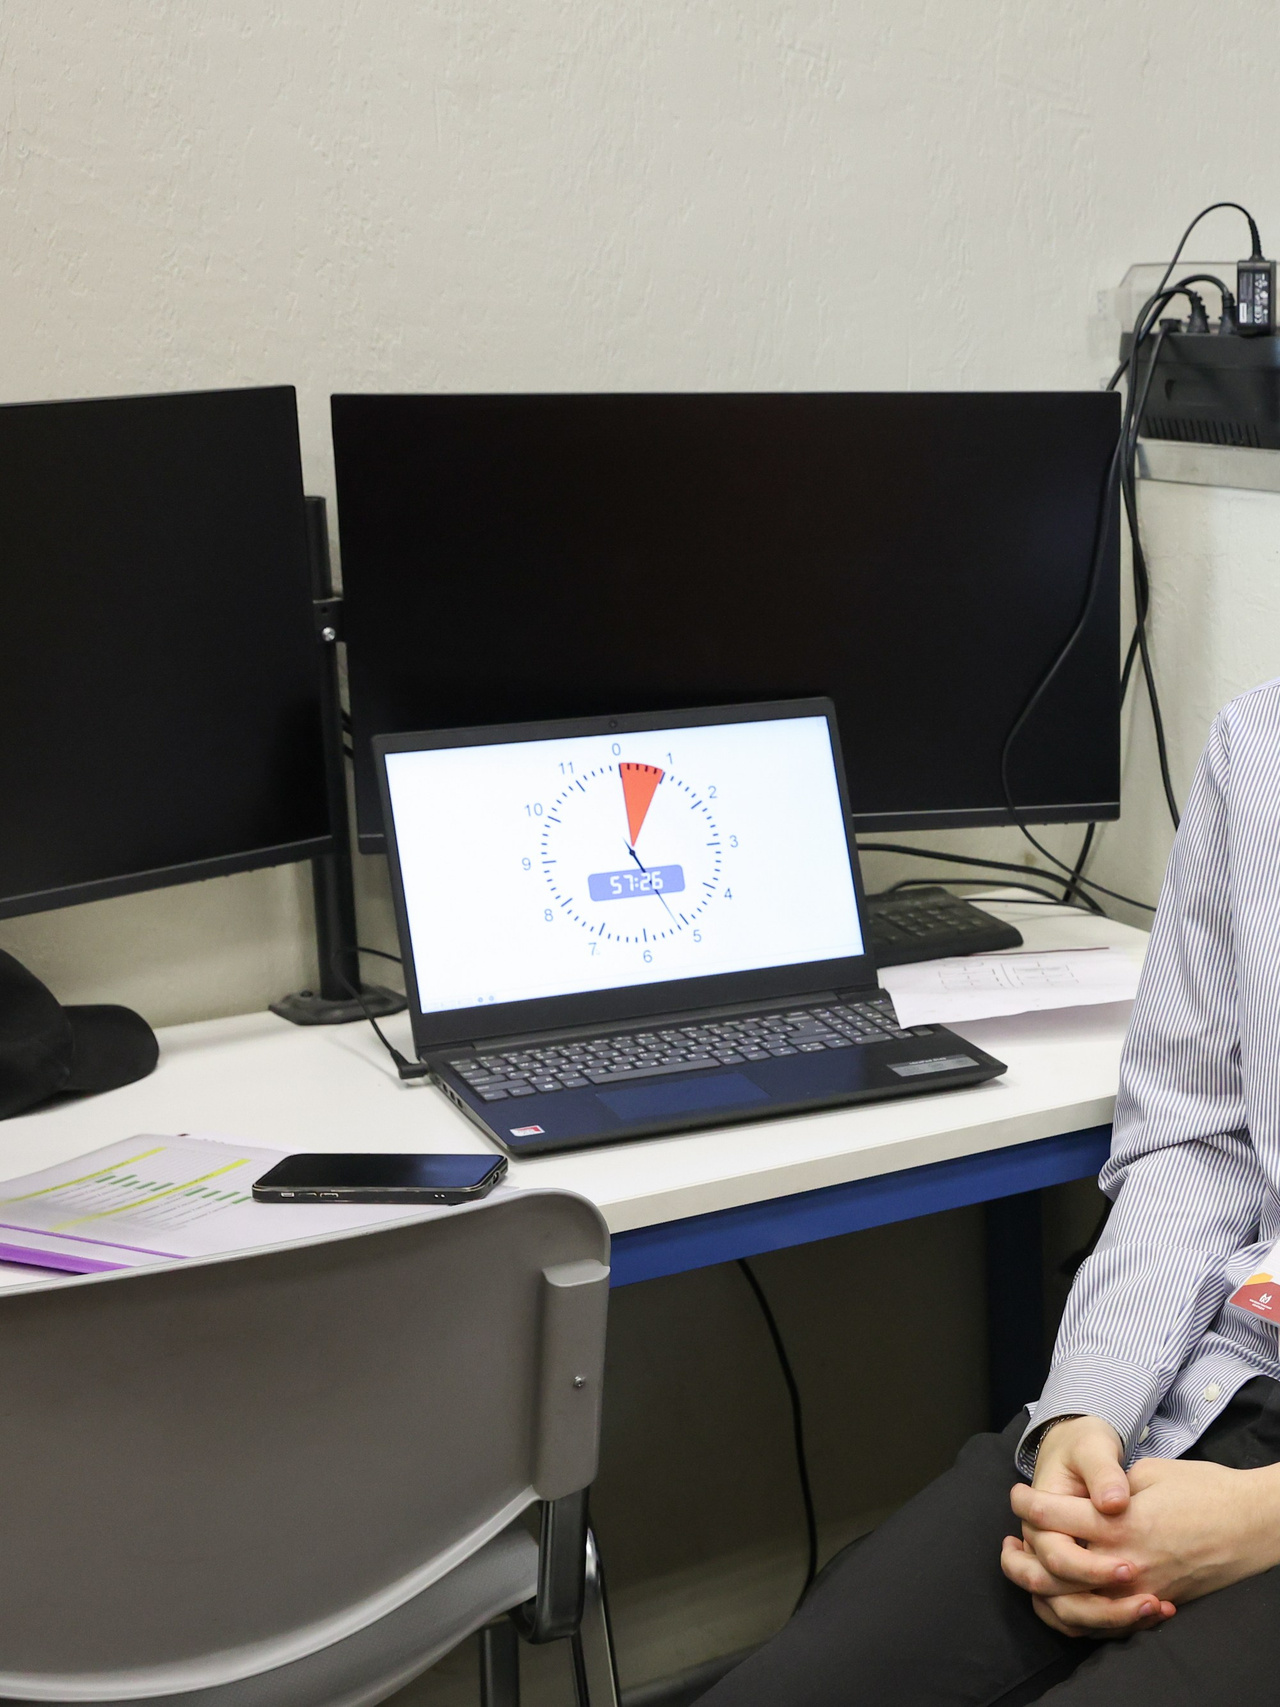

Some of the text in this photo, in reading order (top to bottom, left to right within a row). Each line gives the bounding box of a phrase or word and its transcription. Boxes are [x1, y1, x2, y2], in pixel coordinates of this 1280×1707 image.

[612, 743, 621, 756] 0
[666, 752, 673, 765] 1
[559, 761, 574, 775] 11
[708, 785, 717, 799] 2
[525, 803, 544, 817] 10
[729, 835, 739, 848] 3
[521, 858, 532, 871] 9
[610, 871, 663, 895] 57:26
[724, 887, 733, 900] 4
[544, 909, 554, 922] 8
[693, 929, 702, 943] 5
[588, 942, 597, 956] 7
[643, 950, 653, 963] 6
